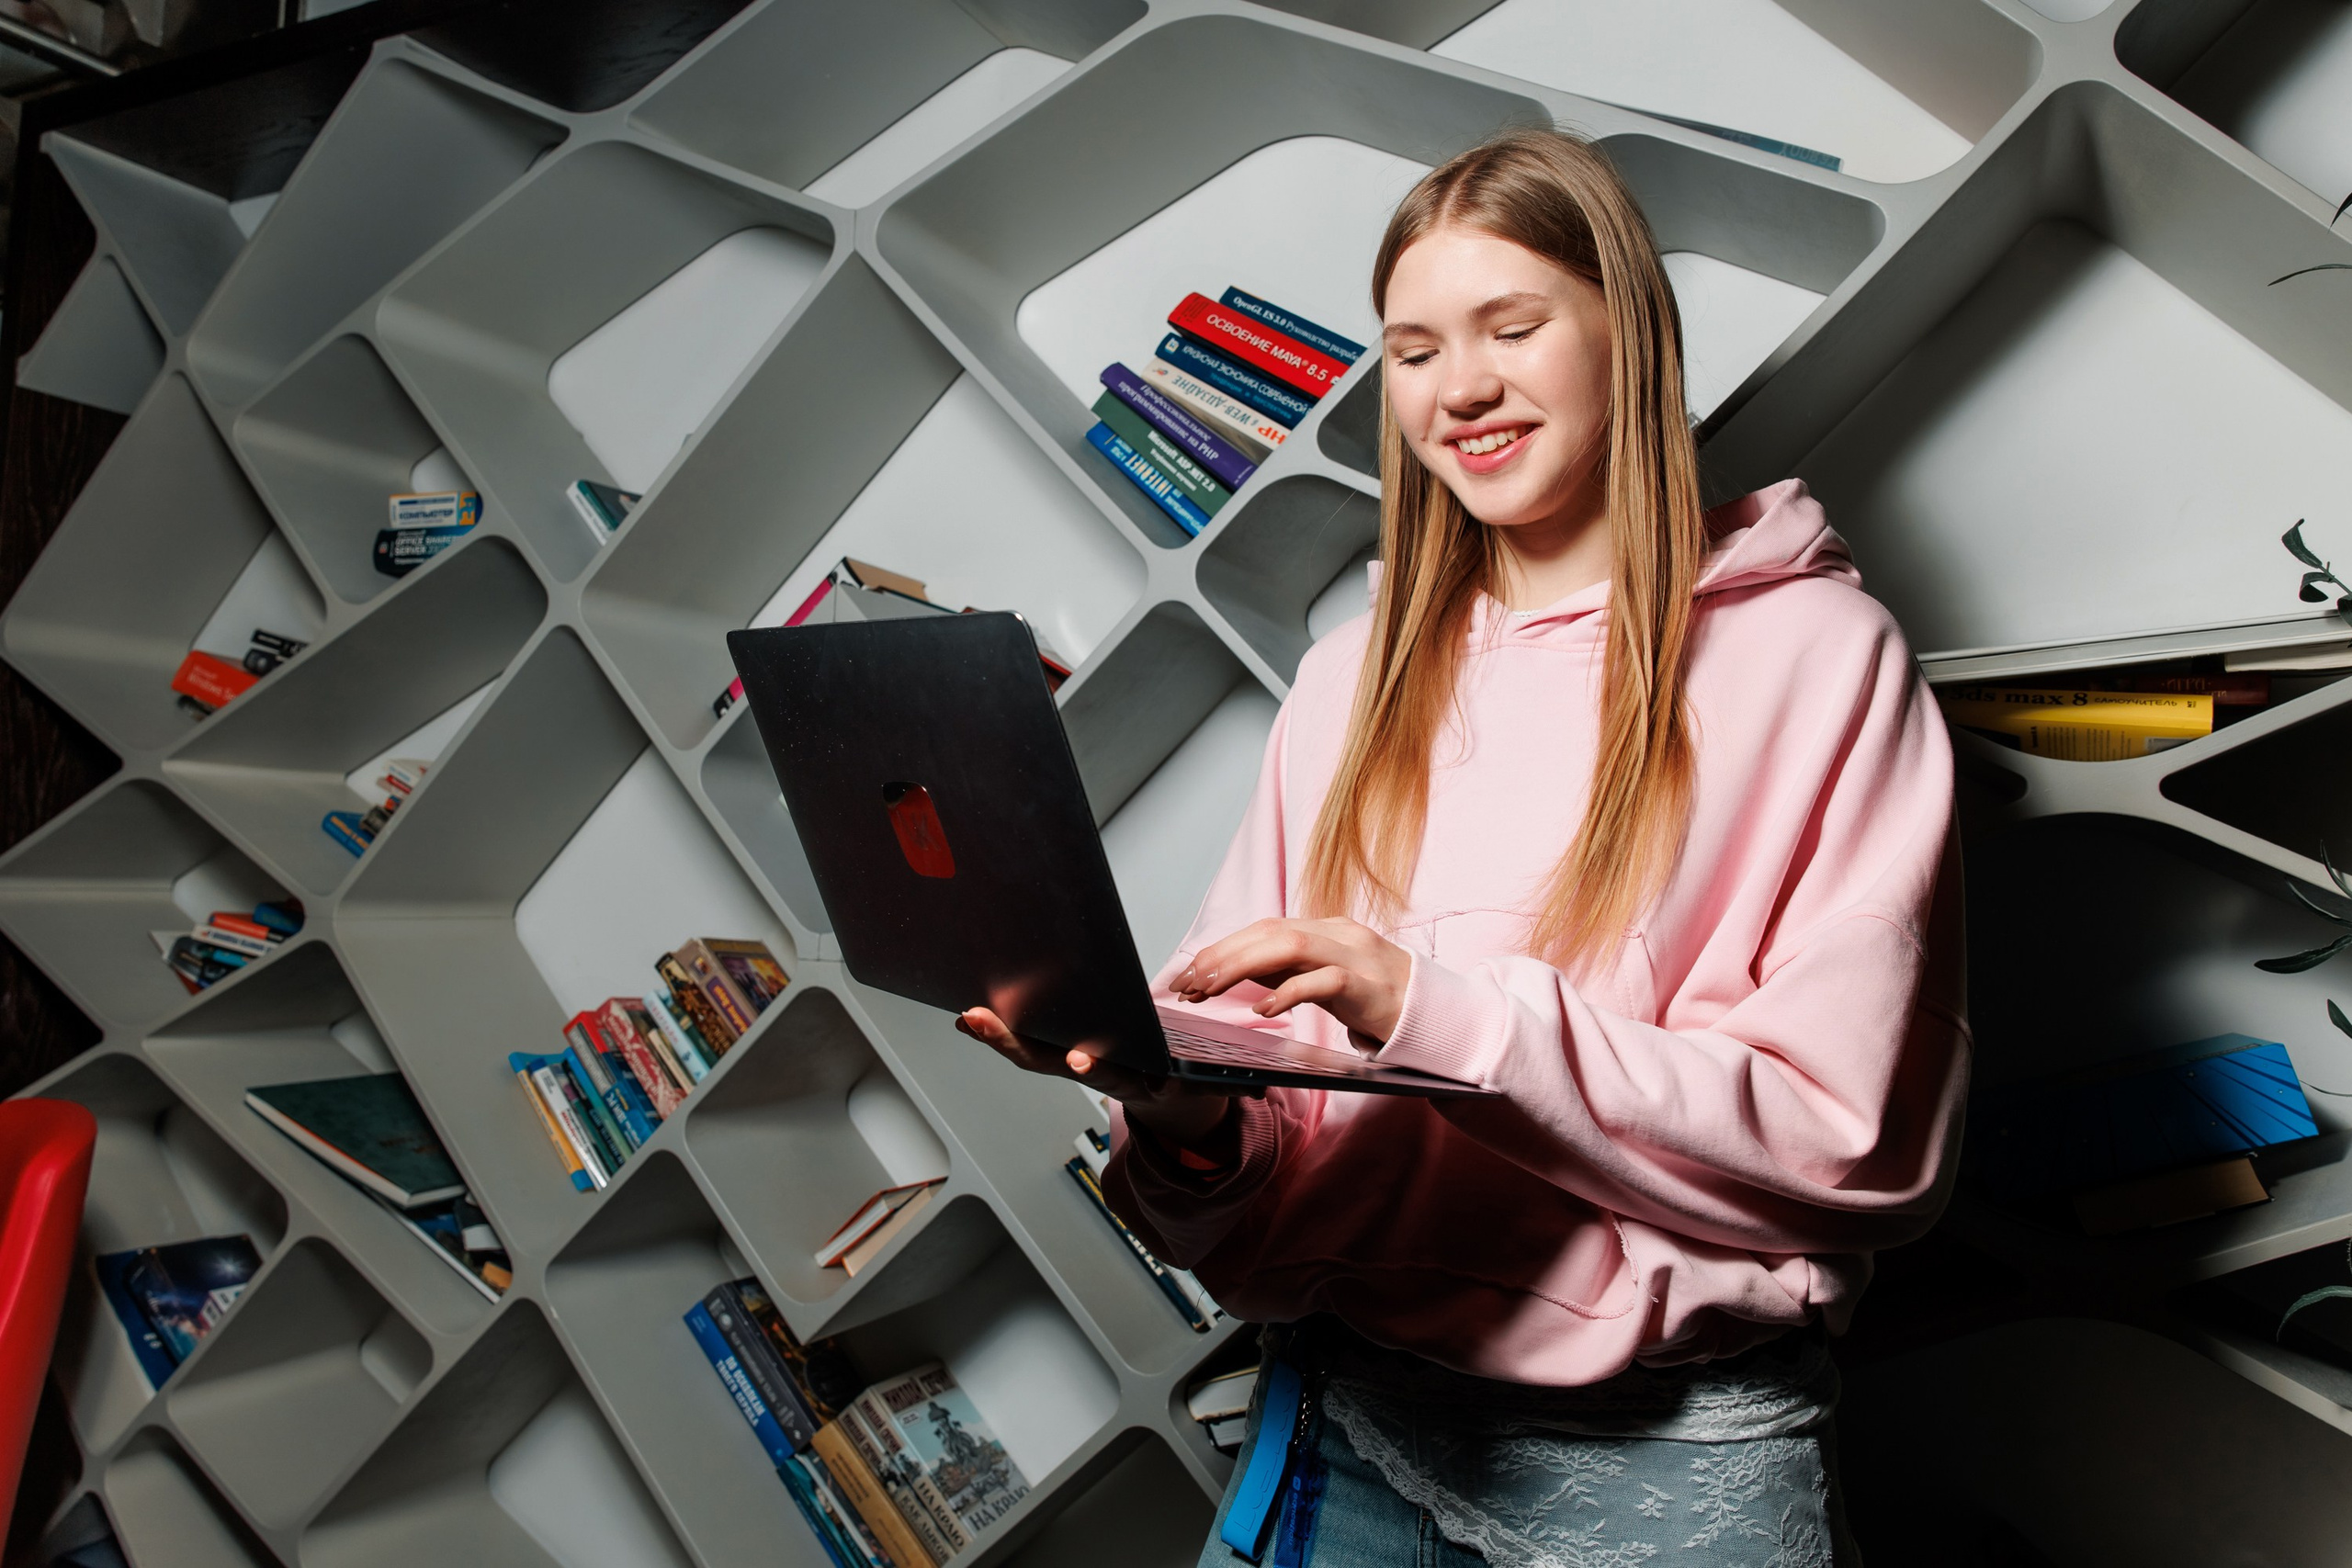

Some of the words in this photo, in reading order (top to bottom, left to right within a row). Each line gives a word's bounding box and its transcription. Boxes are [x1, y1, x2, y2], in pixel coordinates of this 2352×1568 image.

[1231, 295, 1263, 316] OpenGL
[1272, 314, 1287, 326] 3.0
[1205, 311, 1272, 353] ОСВОЕНИЕ
[1306, 362, 1329, 381] 8.5
[1216, 362, 1260, 389] ЭКОНОМИКА
[1136, 382, 1215, 443] Профессиональное
[1170, 373, 1252, 425] WEB-ДИЗАЙНЕ
[1114, 379, 1192, 439] программирование
[1186, 434, 1200, 447] на
[1196, 442, 1219, 462] PHP
[1146, 429, 1180, 459] Microsoft
[1174, 455, 1205, 482] ASP.NET
[1200, 477, 1216, 492] 2.0
[398, 508, 453, 520] КОМПЬЮТЕР
[393, 545, 425, 556] SERVER
[394, 536, 424, 546] OFFICE
[2005, 694, 2064, 705] max
[2072, 692, 2088, 706] 8
[2094, 696, 2178, 707] САМОУЧИТЕЛЬ
[713, 1359, 740, 1394] ТВОЕГО
[724, 1355, 739, 1371] ПО
[731, 1367, 766, 1417] ОСКОЛКАМ
[899, 1494, 922, 1521] КАК
[917, 1481, 937, 1505] НА
[932, 1504, 967, 1548] КРАЮ
[968, 1508, 996, 1531] НА
[993, 1484, 1031, 1517] КРАЮ
